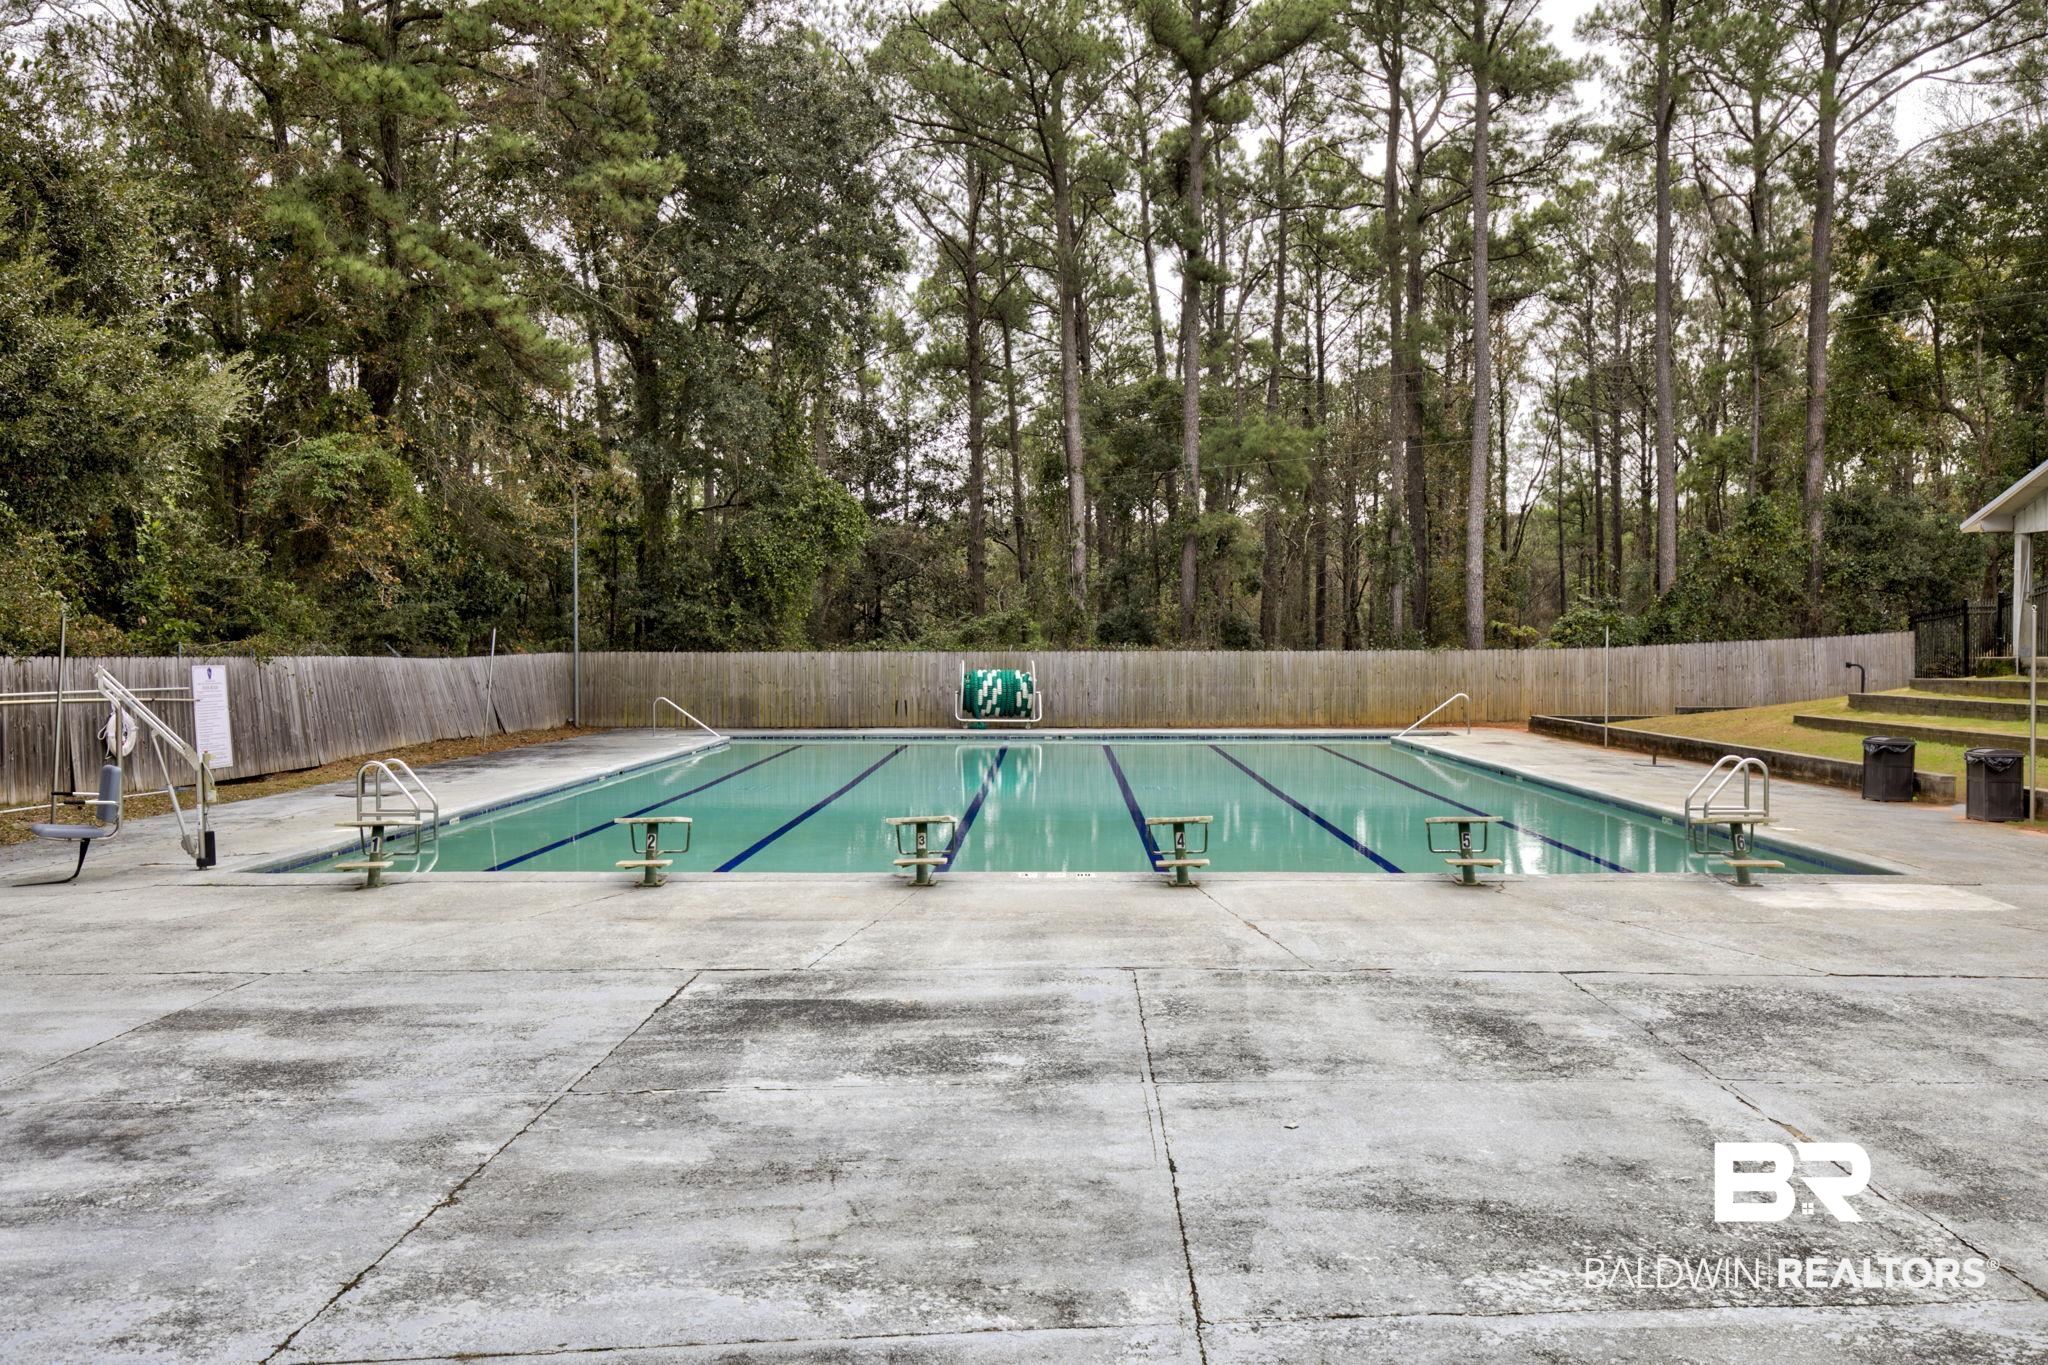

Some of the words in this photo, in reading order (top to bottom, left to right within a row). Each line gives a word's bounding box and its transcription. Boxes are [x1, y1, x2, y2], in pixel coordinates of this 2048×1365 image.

[372, 837, 379, 852] 1
[647, 834, 656, 849] 2
[918, 835, 925, 846] 3
[1177, 833, 1185, 848] 4
[1463, 833, 1471, 848] 5
[1737, 834, 1745, 850] 6
